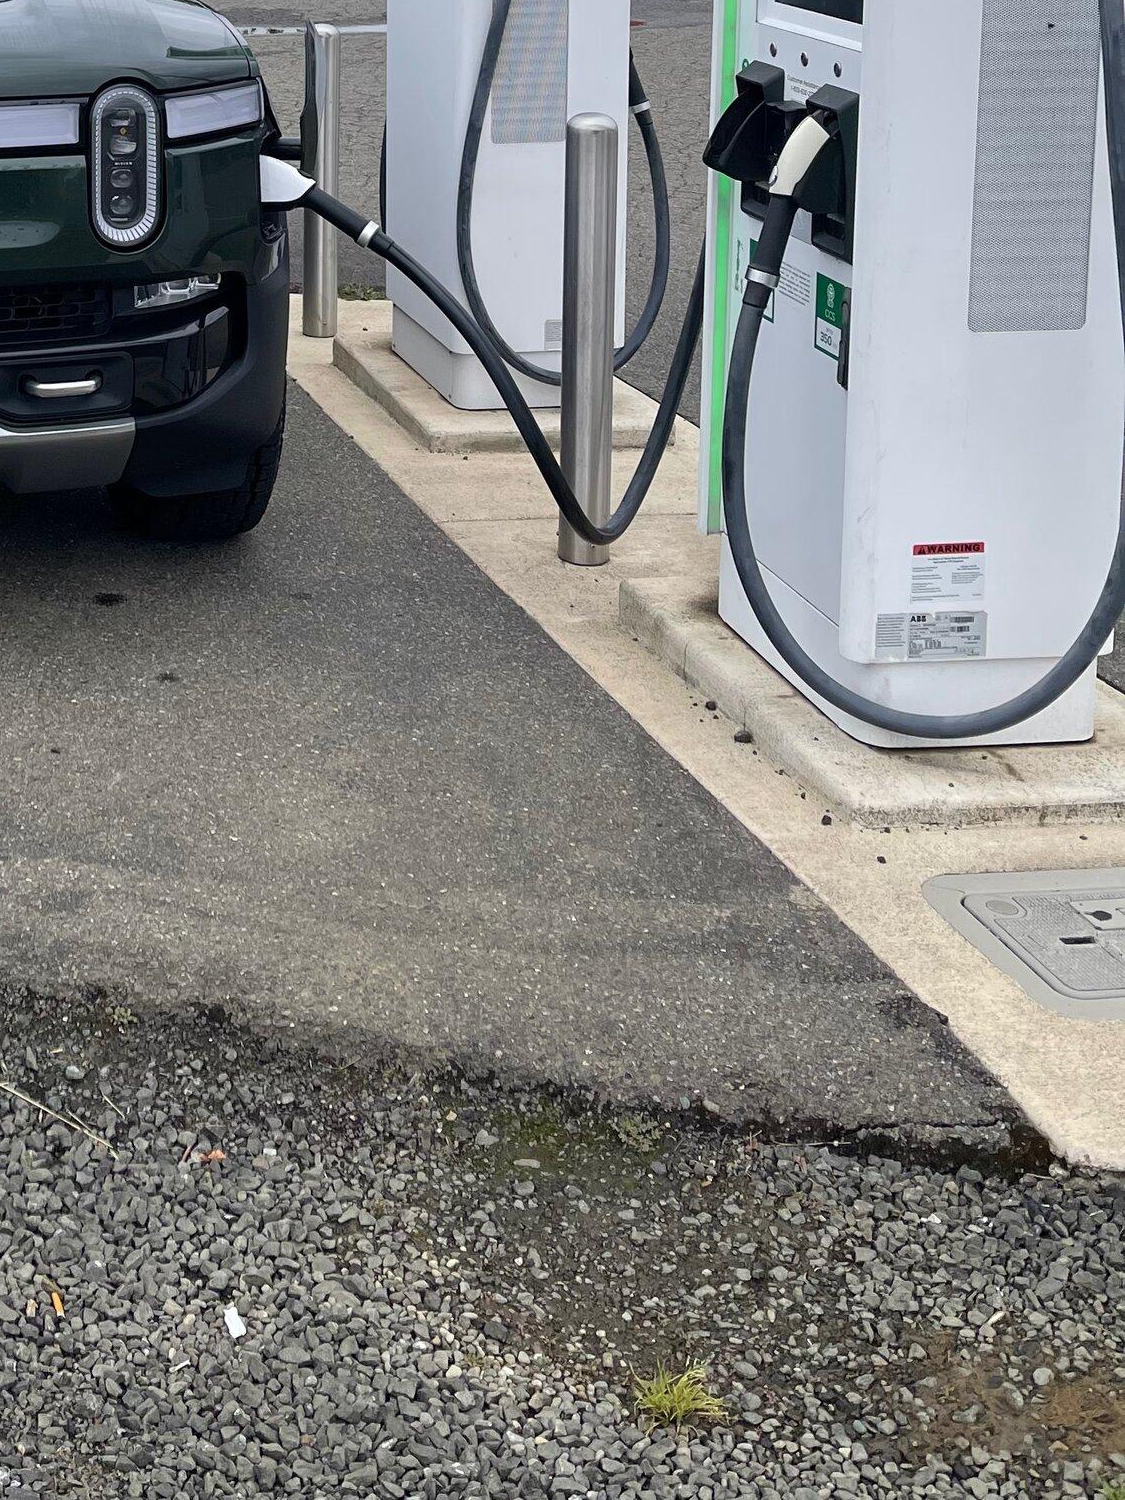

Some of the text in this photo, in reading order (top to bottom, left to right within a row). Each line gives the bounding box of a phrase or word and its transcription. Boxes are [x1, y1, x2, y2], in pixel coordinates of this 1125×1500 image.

[819, 331, 833, 346] 350
[927, 543, 981, 554] WARNING
[910, 615, 927, 623] ABB
